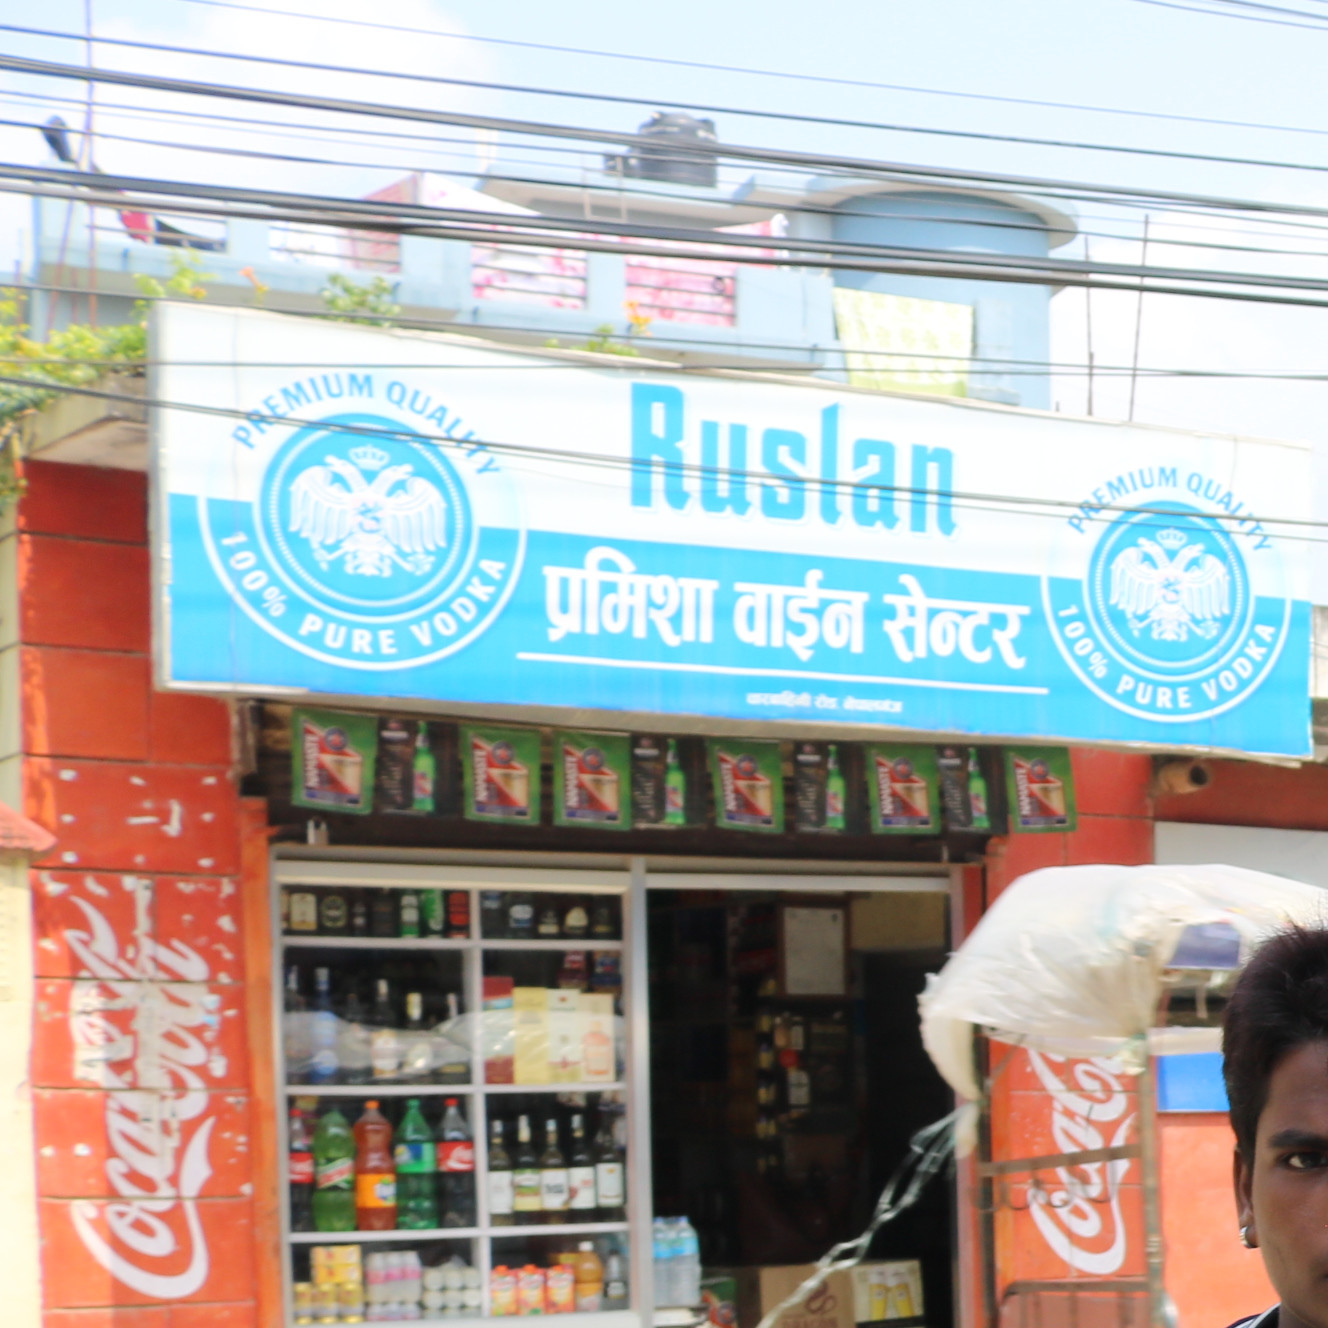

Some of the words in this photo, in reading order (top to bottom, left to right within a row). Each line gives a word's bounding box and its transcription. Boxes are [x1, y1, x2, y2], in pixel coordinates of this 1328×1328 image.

[231, 372, 375, 451] PREMIUM
[386, 380, 503, 478] QUALITY
[631, 383, 957, 535] Ruslan
[1067, 466, 1178, 535] PREMIUM
[1186, 471, 1273, 553] QUALITY
[219, 529, 289, 618] 100%
[298, 613, 398, 656] PURE
[409, 557, 508, 648] VODKA
[541, 545, 719, 647] प्रमिशा
[734, 569, 868, 663] वाईन
[882, 573, 1031, 669] सेन्टर
[1055, 604, 1110, 680] 100%
[1115, 672, 1193, 710] PURE
[1202, 620, 1277, 703] VODKA
[1026, 1048, 1137, 1274] Coca-C
